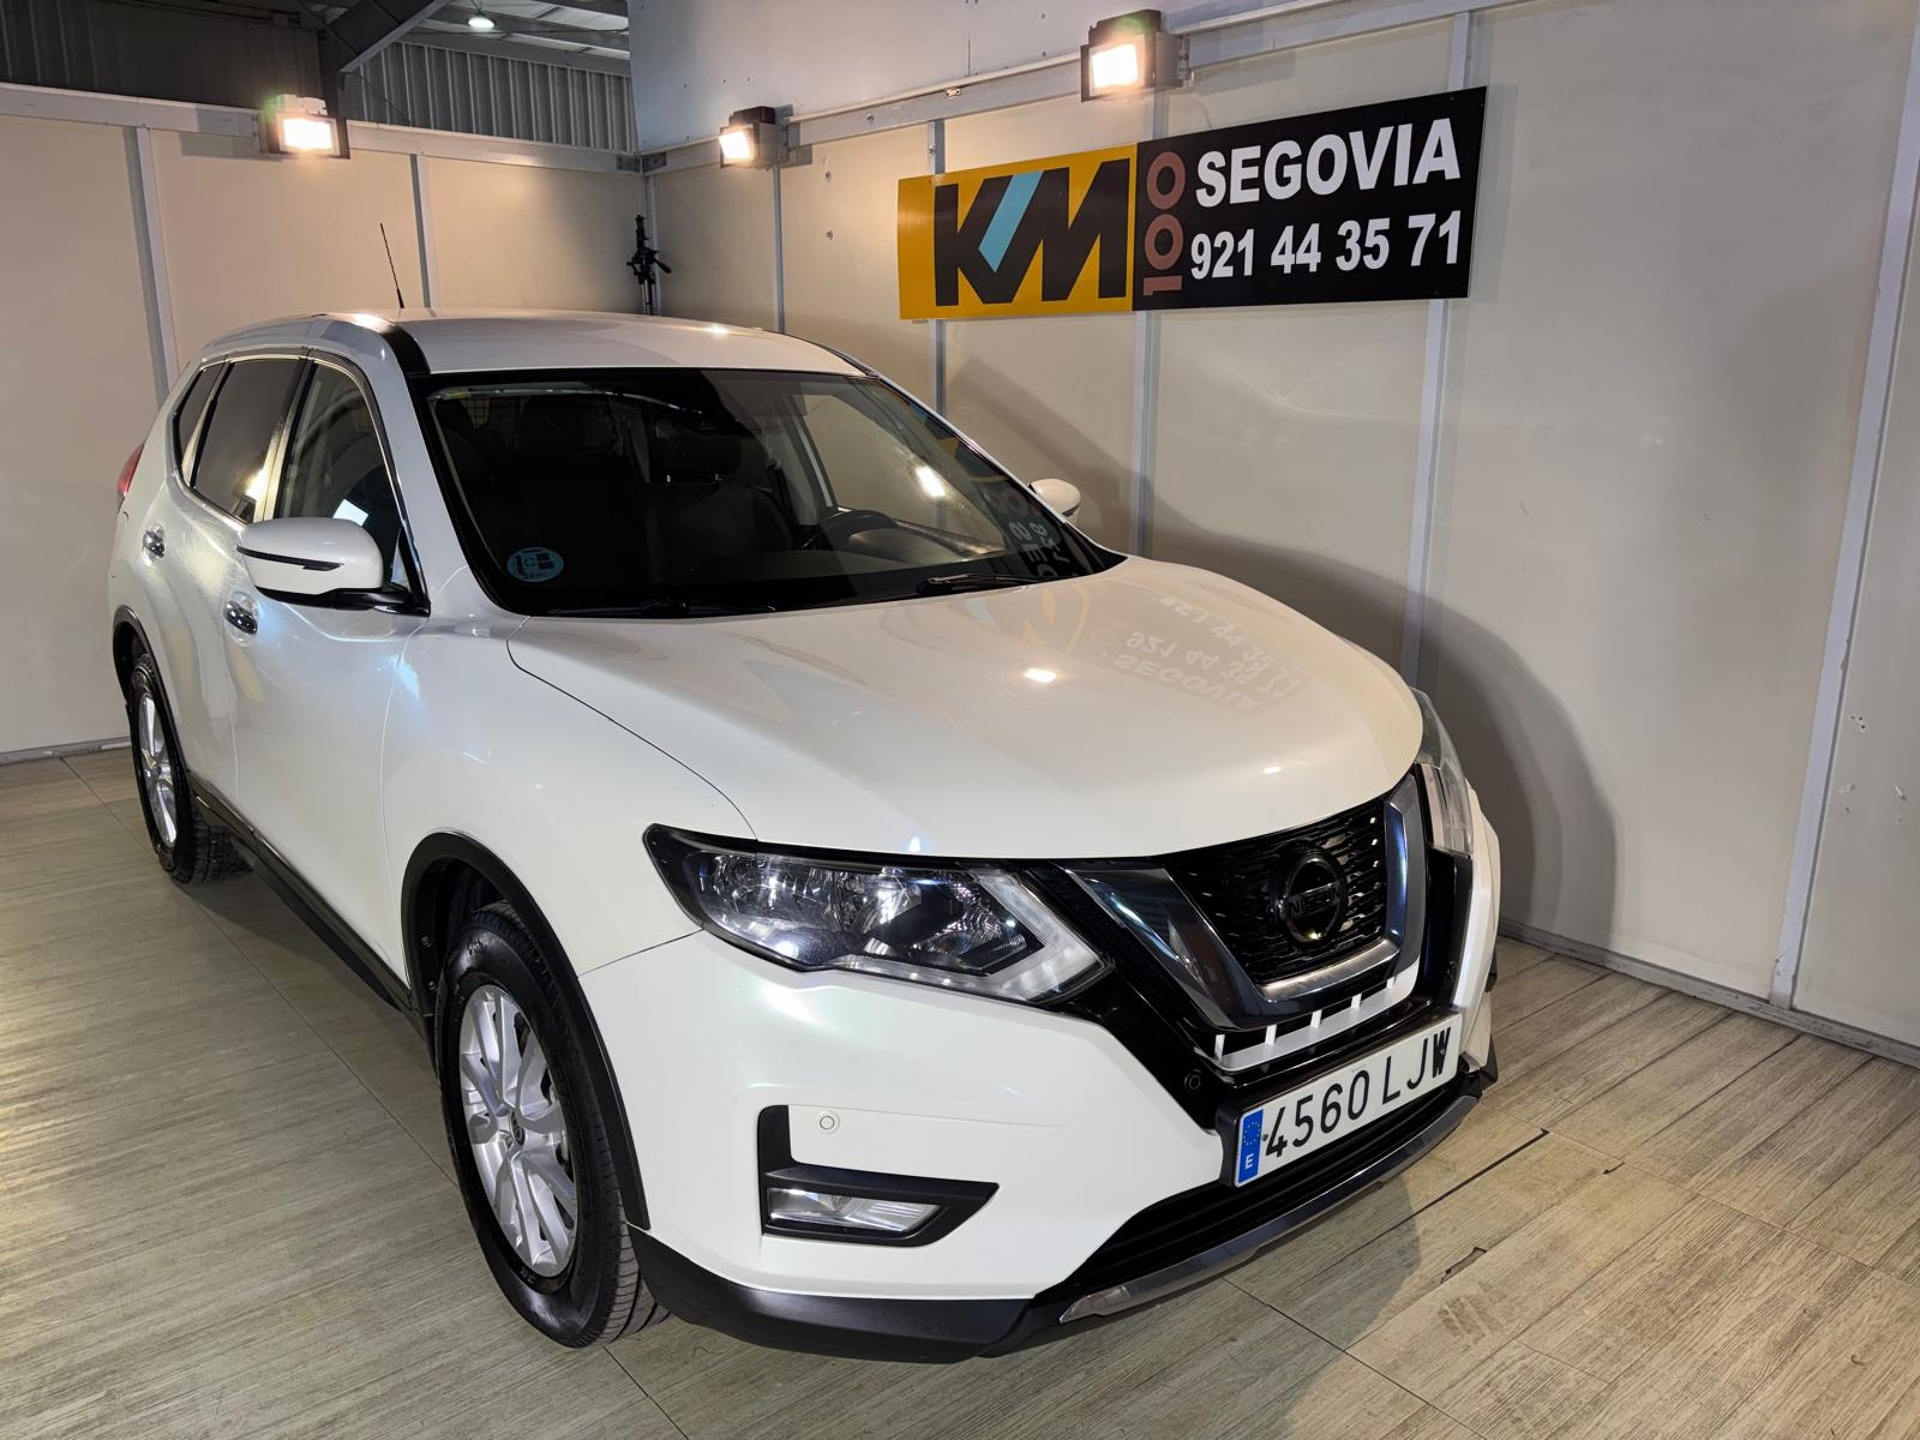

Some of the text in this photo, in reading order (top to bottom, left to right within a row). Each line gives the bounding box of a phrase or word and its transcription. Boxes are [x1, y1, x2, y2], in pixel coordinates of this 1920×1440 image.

[1195, 117, 1461, 208] SEGOVIA
[934, 158, 1131, 307] KM
[1143, 151, 1186, 297] 100
[1190, 210, 1461, 279] 921 44 35 71
[1265, 1027, 1452, 1158] 4560 LJW
[1244, 1153, 1254, 1170] E
